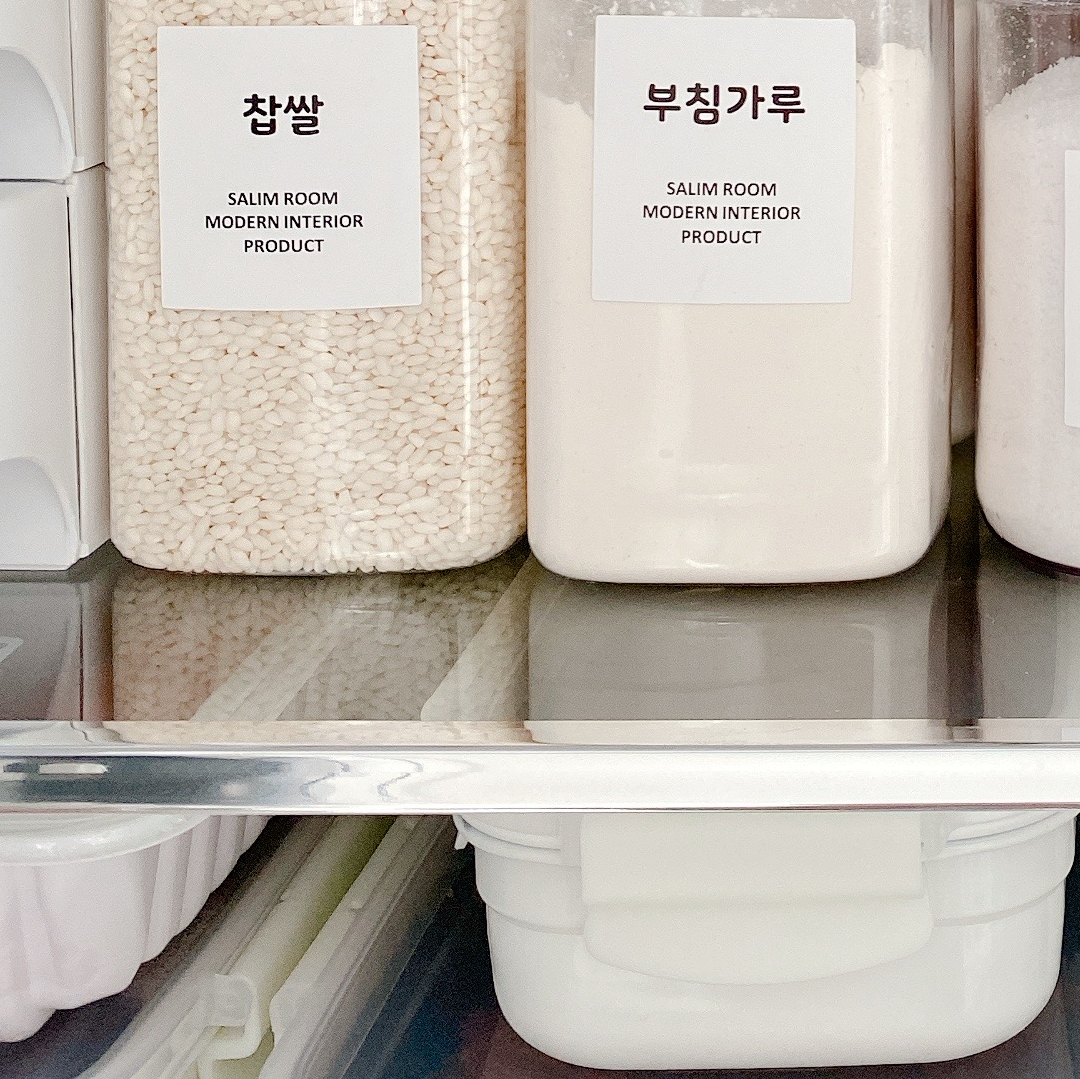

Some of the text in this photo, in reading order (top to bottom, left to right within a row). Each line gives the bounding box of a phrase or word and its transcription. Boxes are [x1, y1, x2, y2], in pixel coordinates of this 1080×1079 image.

[644, 83, 805, 125] 부침가루
[243, 94, 324, 135] 찹쌀
[667, 182, 776, 196] SALIM ROOM
[228, 192, 337, 205] SALIM ROOM
[643, 205, 800, 220] MODERN INTERIOR
[206, 215, 363, 228] MODERN INTERIOR
[682, 230, 761, 243] PRODUCT
[245, 240, 324, 252] PRODUCT
